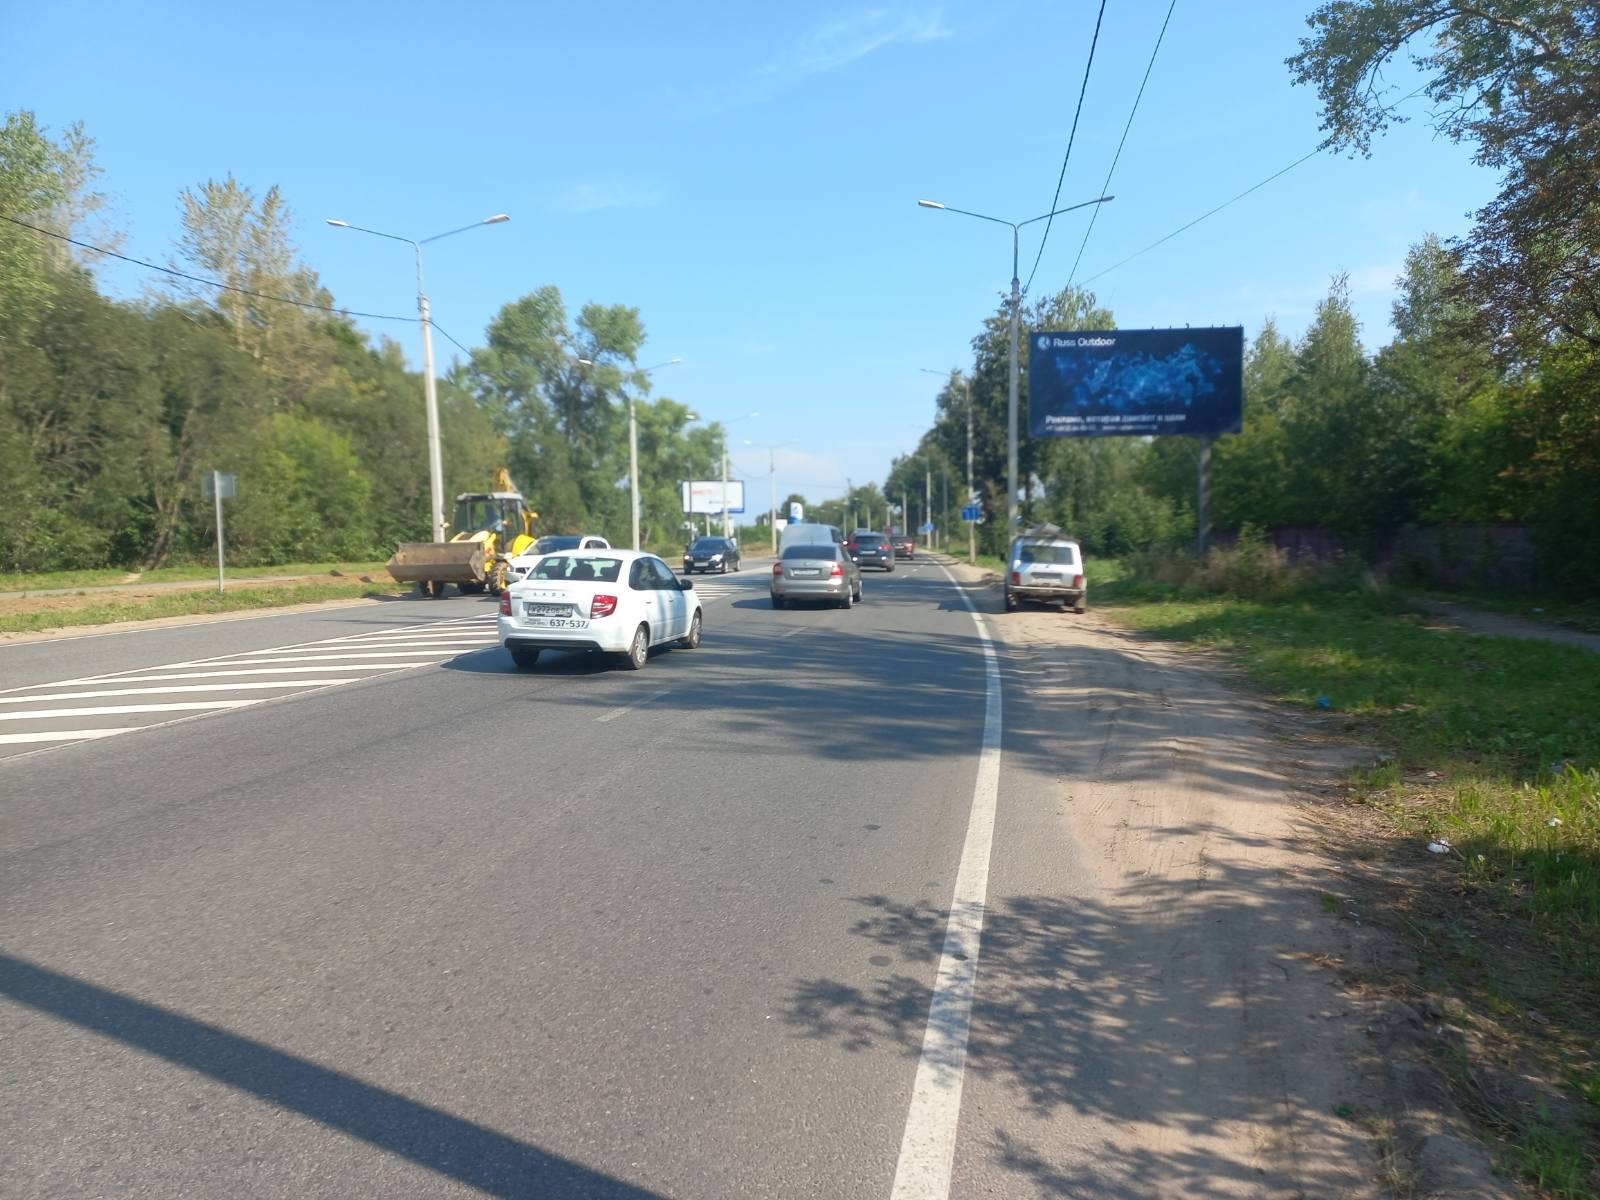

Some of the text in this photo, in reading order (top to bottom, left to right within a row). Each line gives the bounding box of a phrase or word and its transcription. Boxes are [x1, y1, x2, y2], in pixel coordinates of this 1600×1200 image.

[1053, 337, 1116, 347] Russ Outdoor
[550, 619, 586, 628] 637-537
